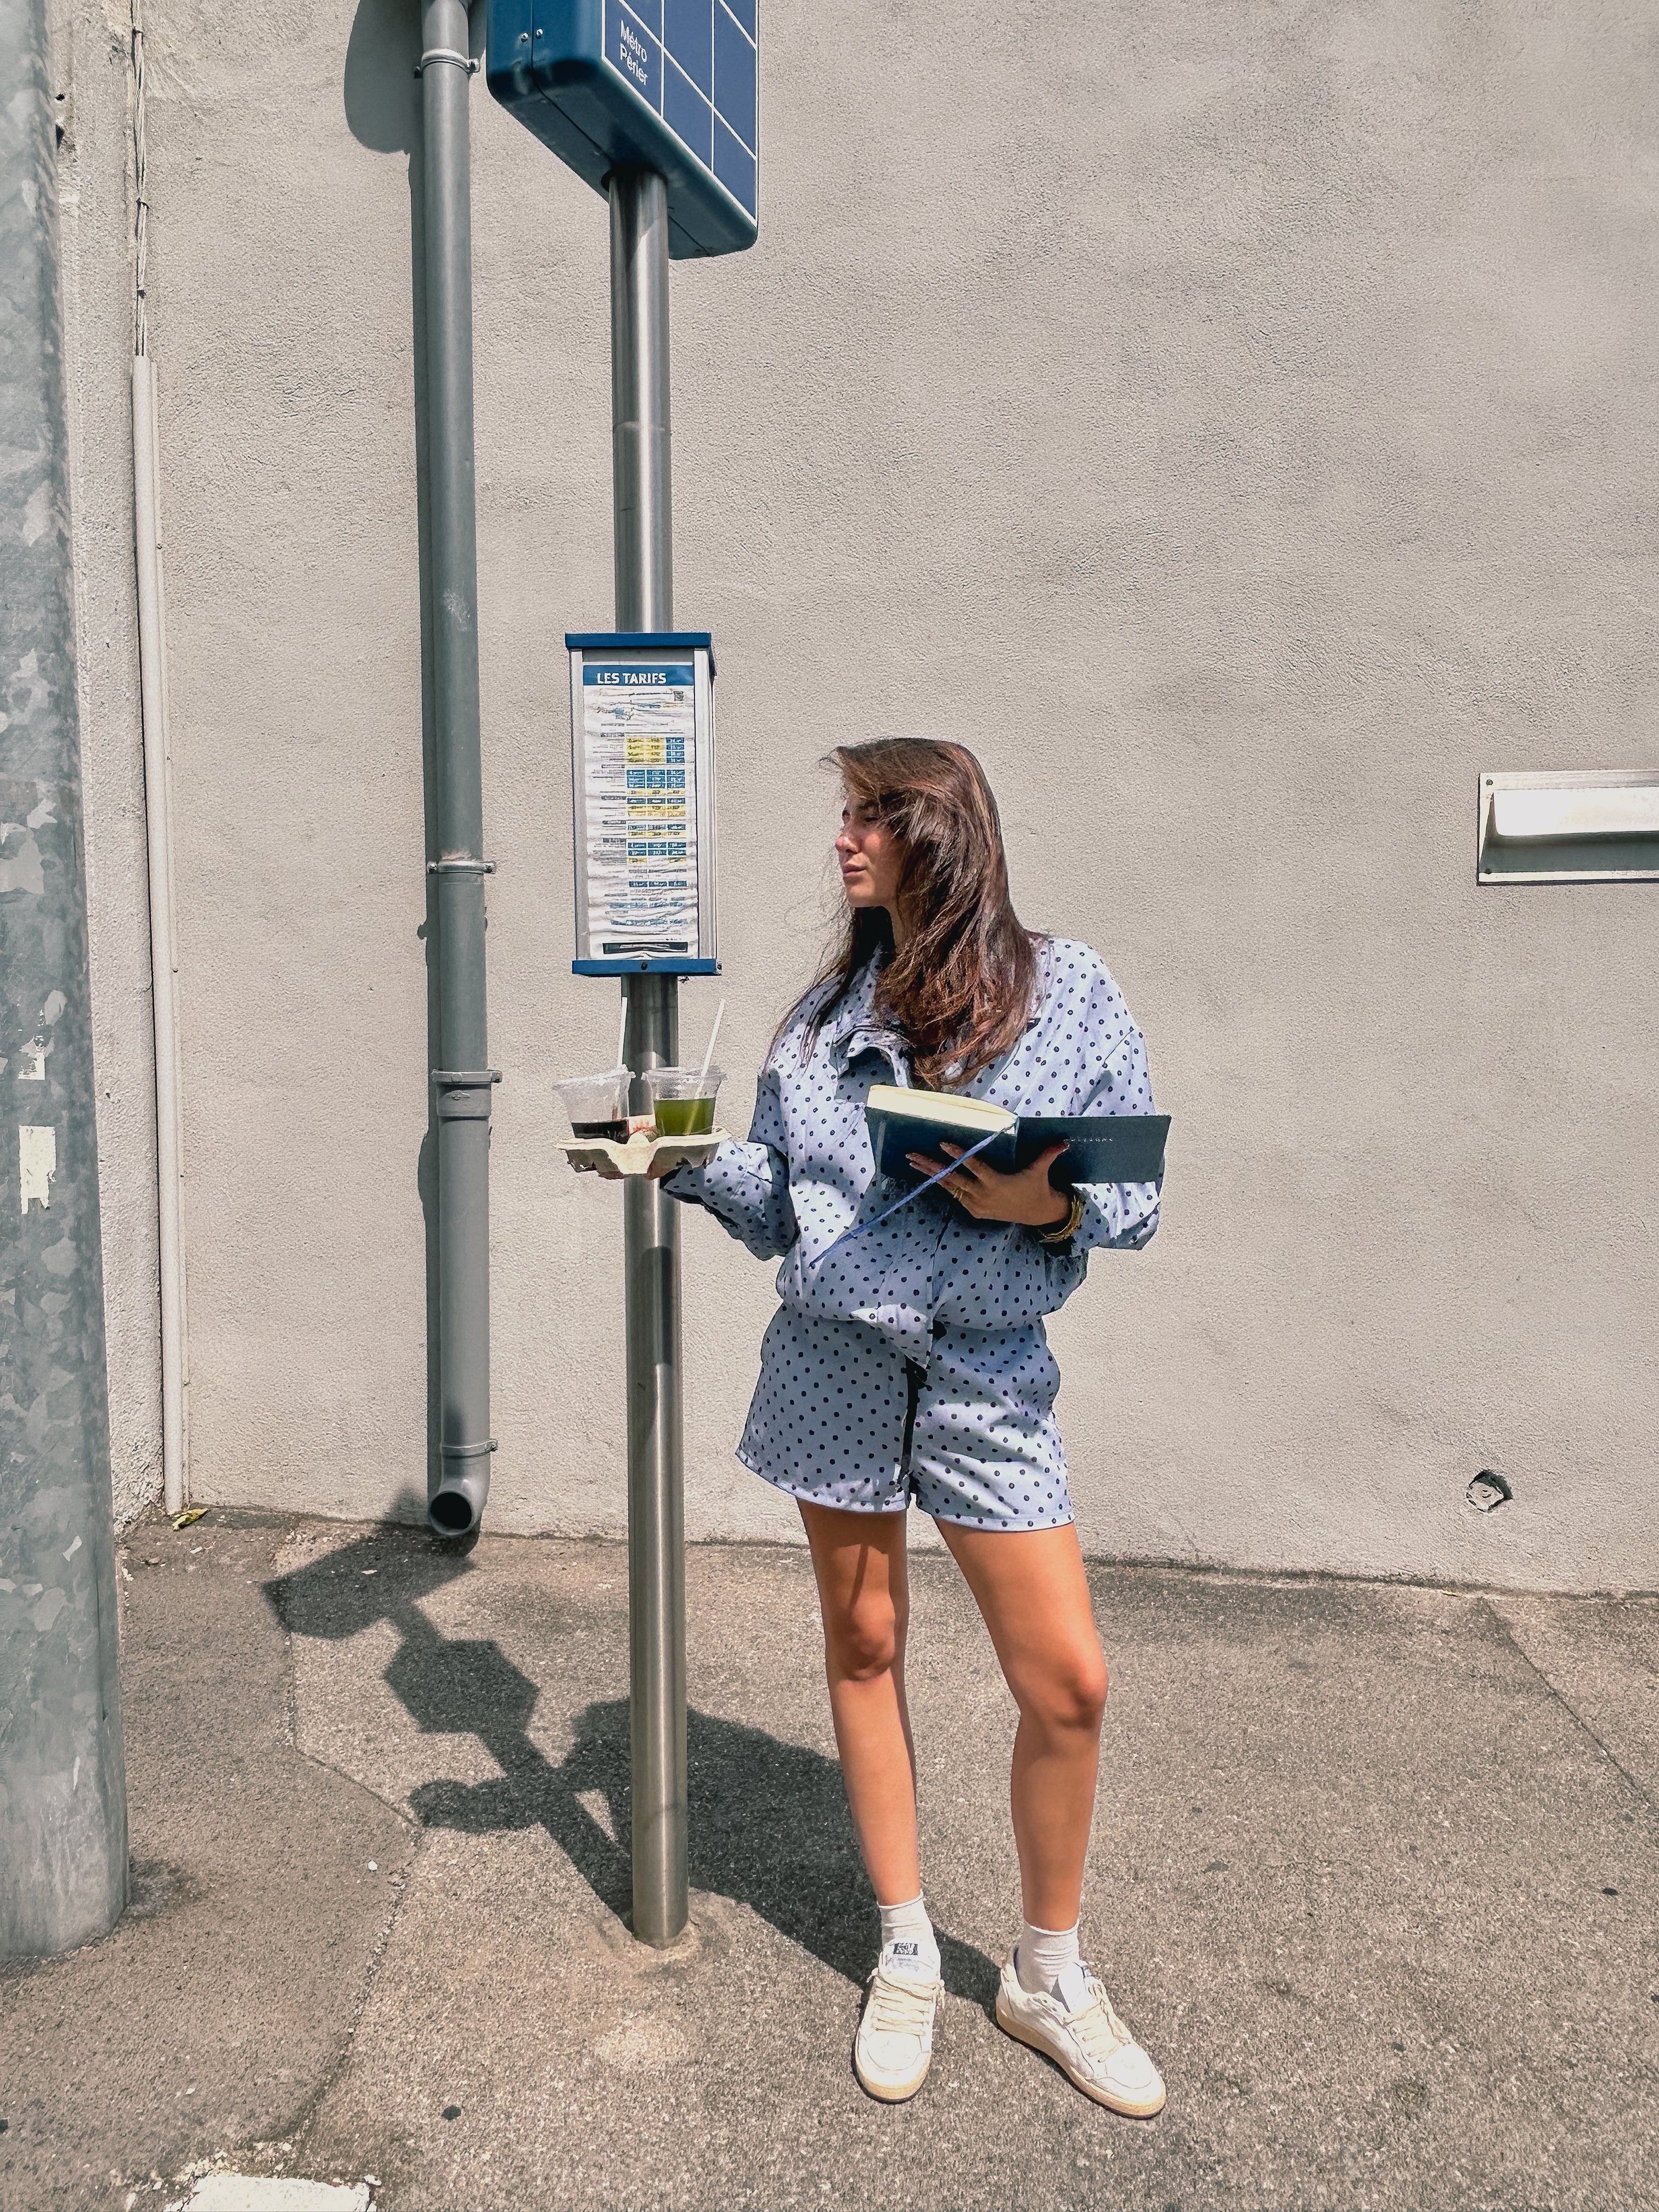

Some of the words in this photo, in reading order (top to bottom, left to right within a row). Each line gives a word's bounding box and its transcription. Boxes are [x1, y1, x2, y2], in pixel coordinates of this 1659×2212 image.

[620, 19, 647, 63] Métro
[620, 42, 648, 86] Périer
[597, 673, 620, 684] LES
[622, 673, 667, 684] TARIFS
